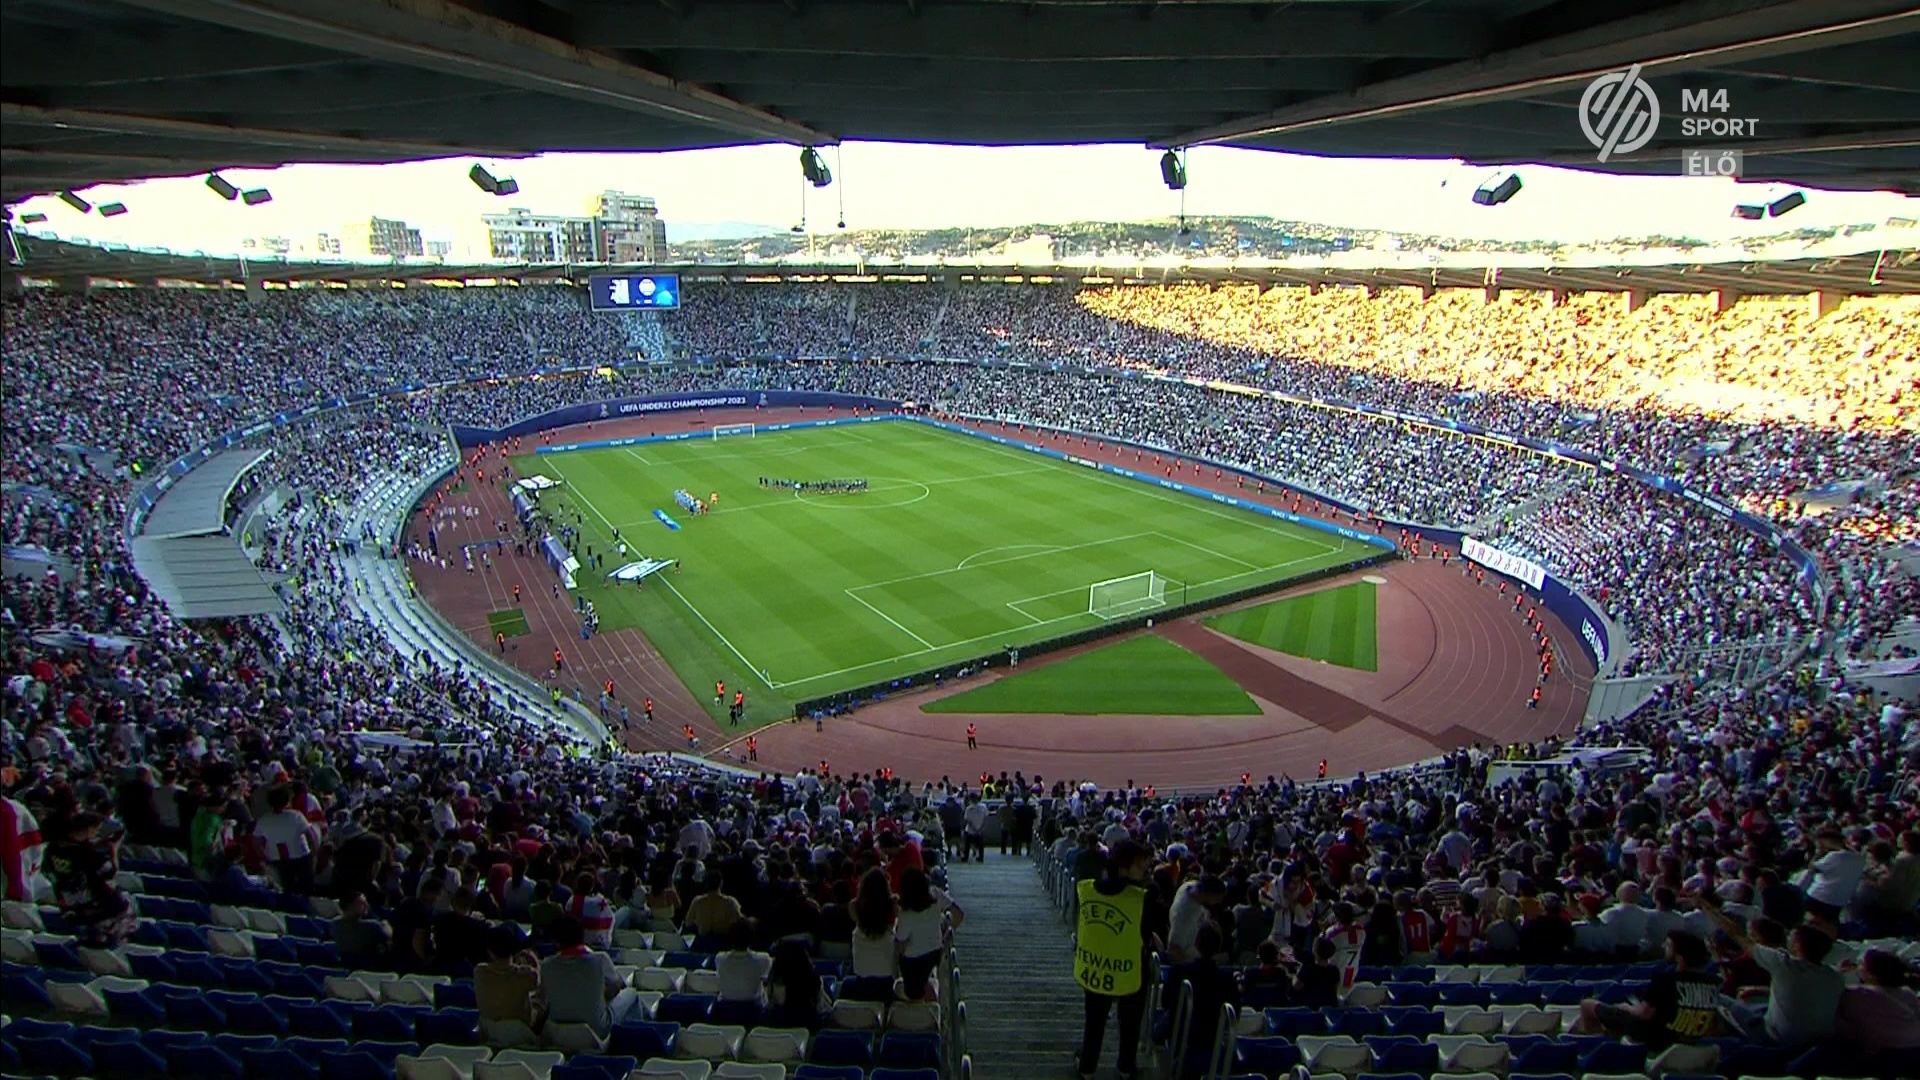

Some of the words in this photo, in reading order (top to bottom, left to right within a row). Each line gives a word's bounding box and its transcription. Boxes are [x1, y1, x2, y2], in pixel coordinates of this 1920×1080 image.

[620, 404, 638, 413] UEFA
[672, 398, 727, 409] CHAMPIONSHIP
[727, 397, 746, 405] 2023
[1409, 922, 1422, 939] 11
[1077, 946, 1133, 973] TEWARD
[1346, 950, 1358, 966] 7
[1081, 966, 1115, 992] 468
